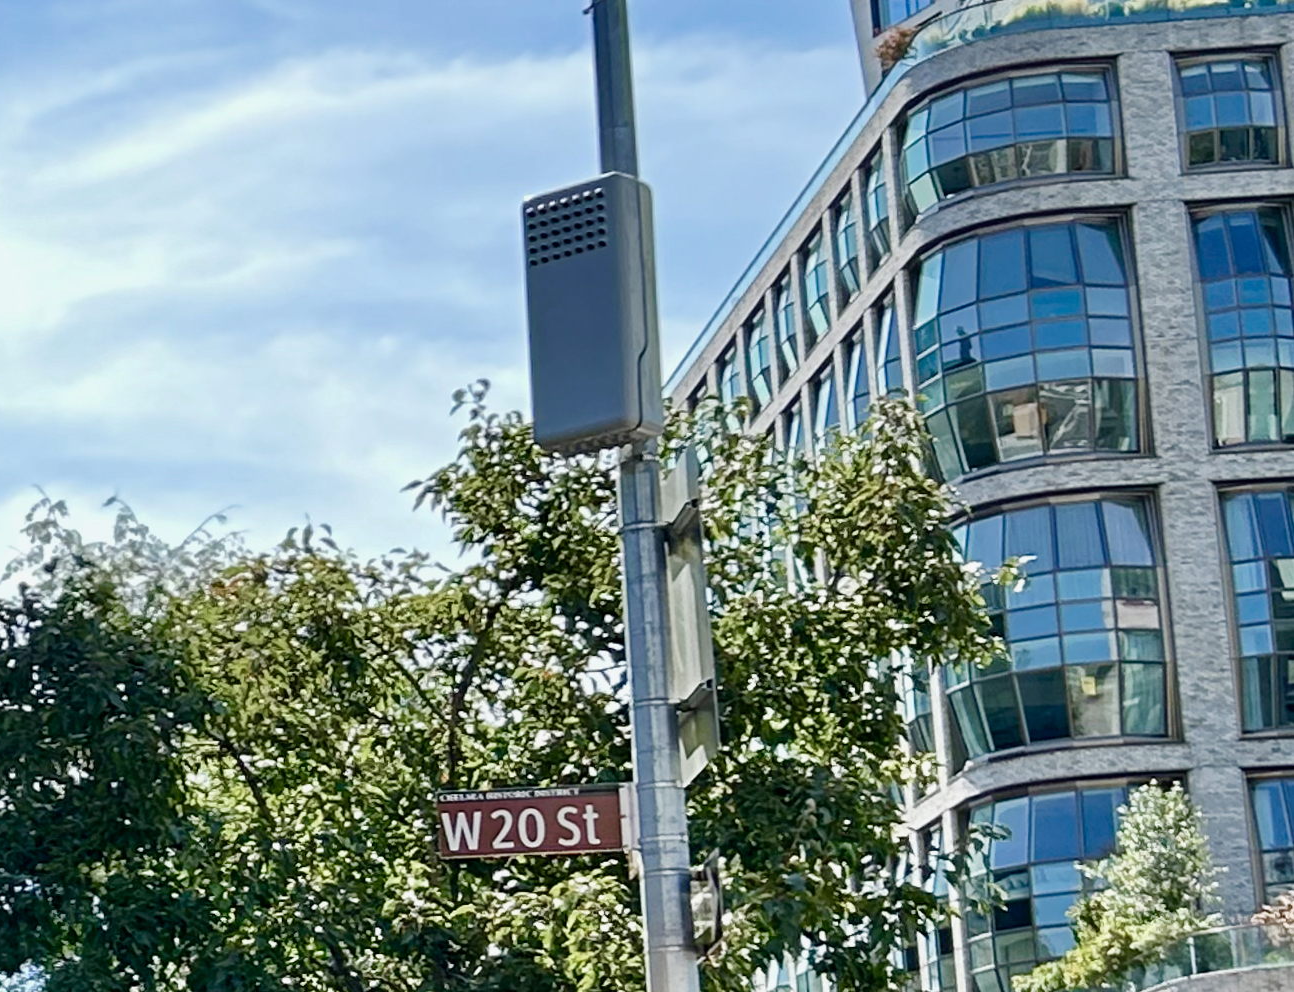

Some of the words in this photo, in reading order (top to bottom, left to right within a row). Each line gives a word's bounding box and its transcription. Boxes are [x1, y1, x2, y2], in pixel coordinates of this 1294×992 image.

[441, 811, 482, 851] W
[490, 807, 546, 849] 20
[556, 804, 601, 847] St
